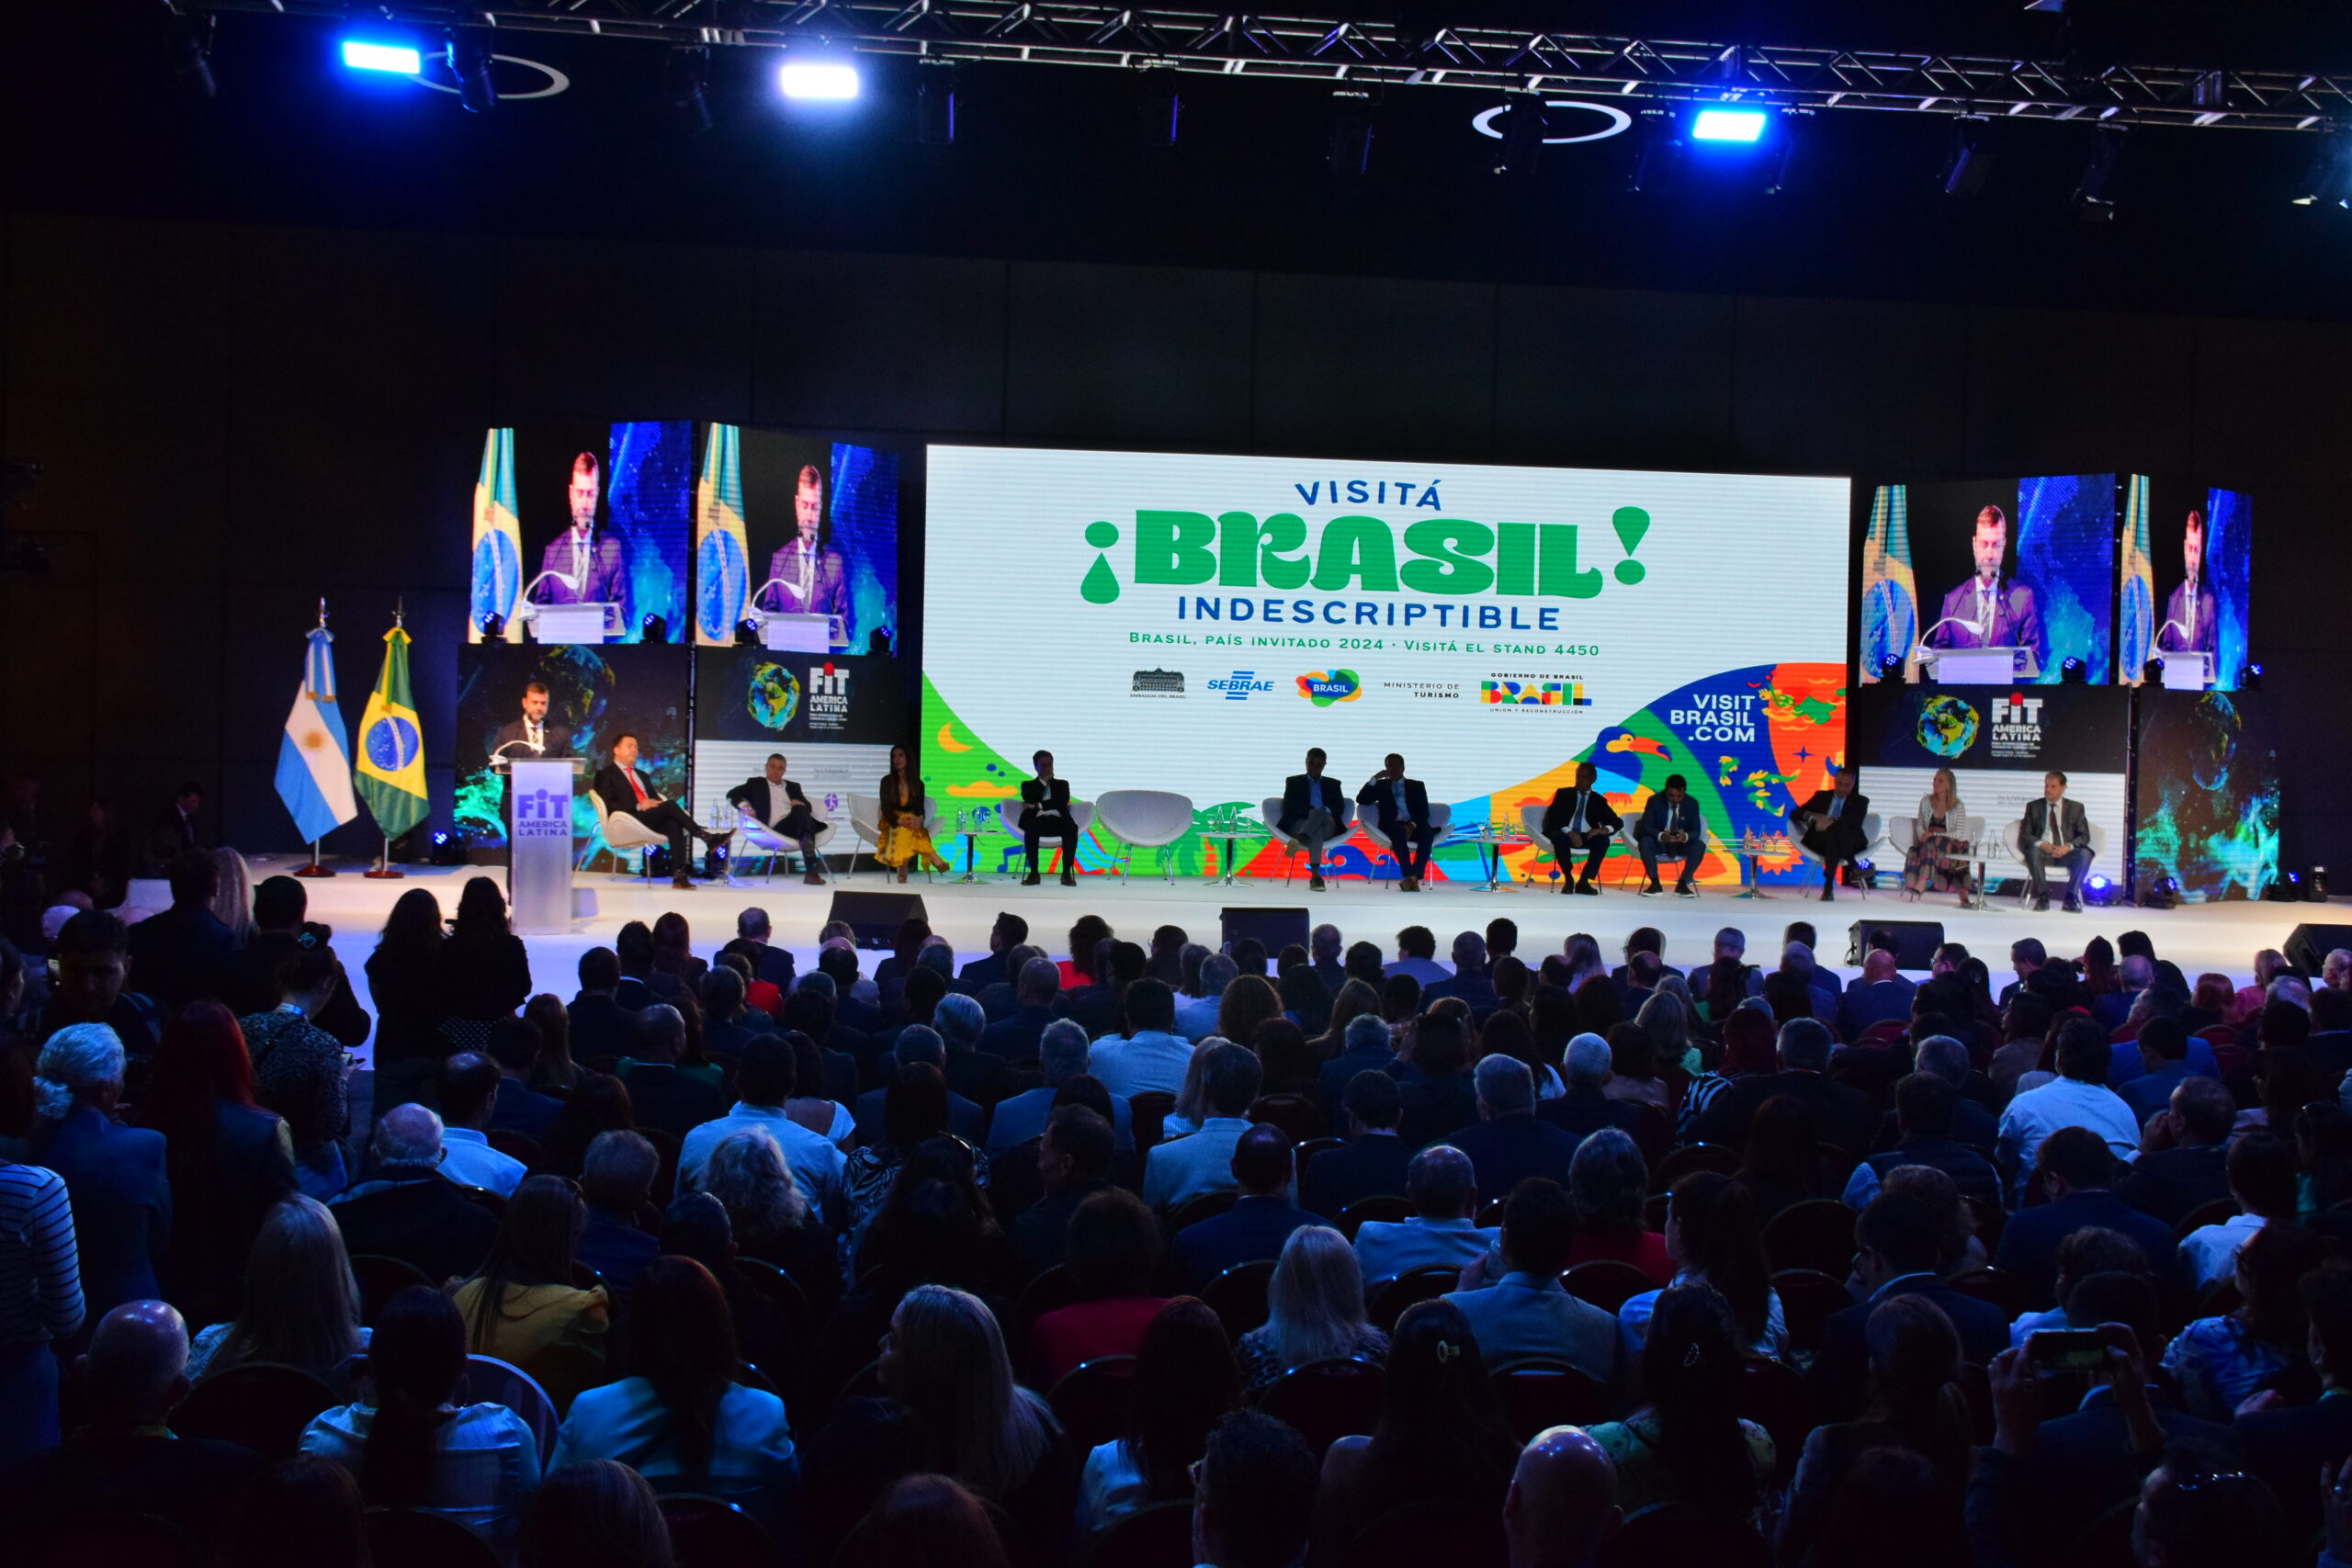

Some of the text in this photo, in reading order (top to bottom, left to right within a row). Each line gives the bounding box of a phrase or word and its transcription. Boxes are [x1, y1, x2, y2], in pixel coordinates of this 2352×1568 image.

[1295, 479, 1442, 511] VISITÁ
[1178, 596, 1559, 631] INDESCRIPTIBLE
[1205, 633, 1243, 646] PAÍS
[1251, 637, 1330, 649] INVITADO
[1339, 637, 1384, 649] 2024
[1404, 639, 1458, 652] VISITÁ
[1465, 643, 1485, 653] EL
[1493, 644, 1545, 655] STAND
[1555, 644, 1600, 656] 4450
[1206, 679, 1275, 692] SEBRAE
[1313, 683, 1349, 693] BRASIL
[1384, 682, 1443, 690] MINISTERIO
[809, 695, 848, 705] AMERICA
[1480, 681, 1592, 706] BRASIL
[809, 704, 848, 713] LATINA
[1692, 694, 1756, 711] VISIT
[1670, 709, 1755, 727] BRASIL
[1688, 726, 1755, 742] .COM
[1992, 724, 2041, 734] AMERICA
[1992, 733, 2041, 741] LATINA
